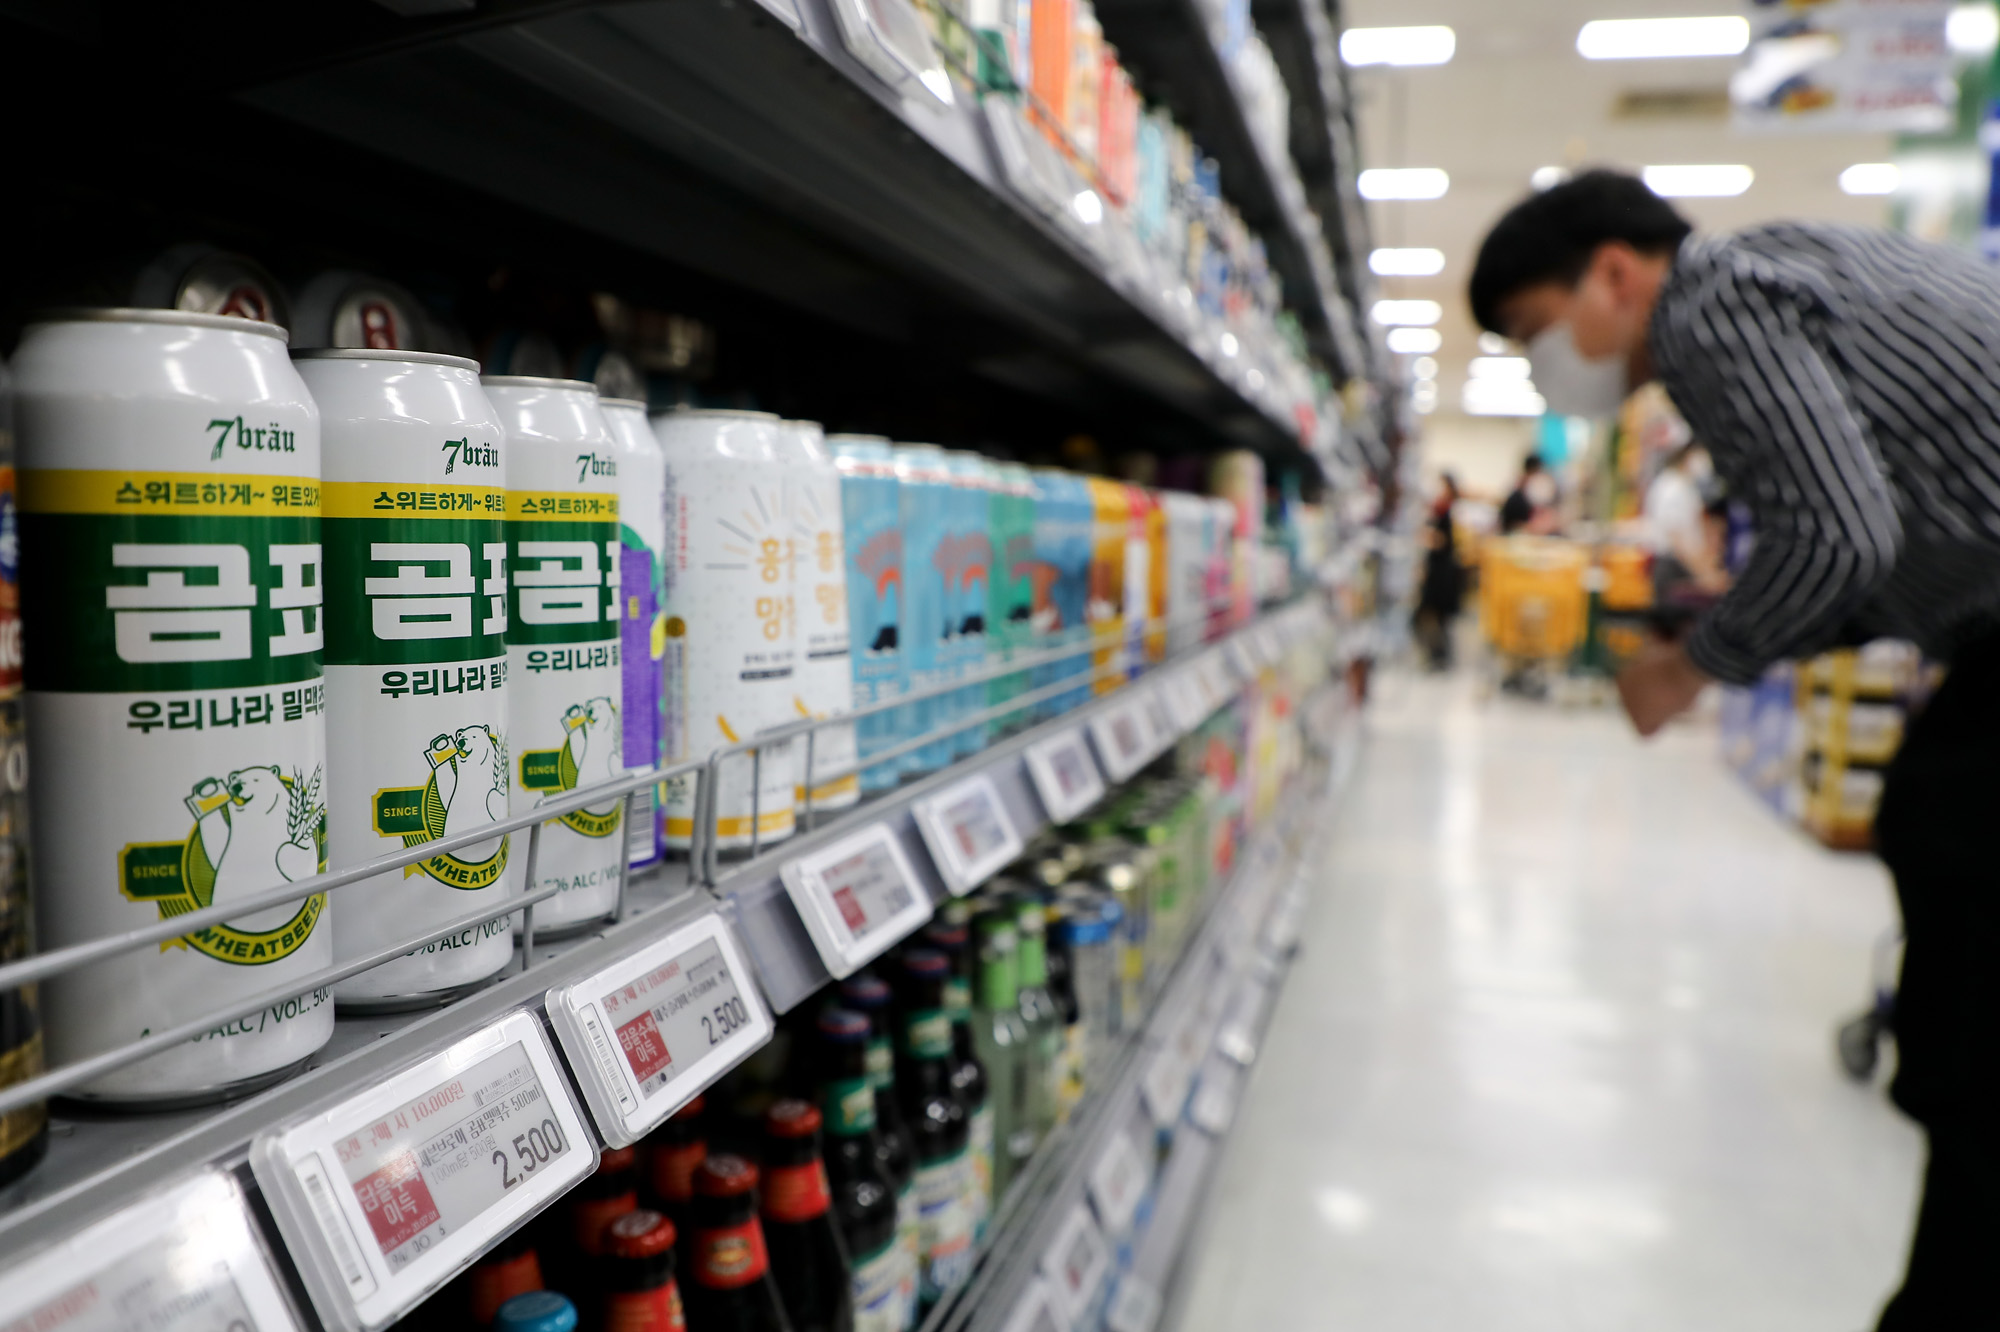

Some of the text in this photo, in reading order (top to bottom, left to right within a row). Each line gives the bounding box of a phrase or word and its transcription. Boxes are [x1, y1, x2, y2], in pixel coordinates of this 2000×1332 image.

[206, 415, 295, 461] 7bräu
[442, 437, 498, 475] 7bräu
[373, 491, 482, 512] 스위트하게~
[525, 646, 609, 674] 우리나라
[380, 664, 487, 699] 우리나라
[127, 692, 274, 735] 우리나라
[527, 765, 556, 776] SINCE
[383, 806, 419, 818] SINCE
[132, 864, 178, 879] SINCE
[572, 871, 597, 891] ALC
[194, 897, 319, 959] WHEATBEER
[440, 929, 471, 952] ALC
[394, 1111, 410, 1131] 시
[411, 1080, 467, 1122] 10,000원
[466, 1101, 510, 1140] 곰표밀맥주
[510, 1083, 542, 1112] 500ml
[469, 1133, 498, 1162] 500원
[492, 1118, 563, 1190] 2,500
[382, 1191, 419, 1226] 이득
